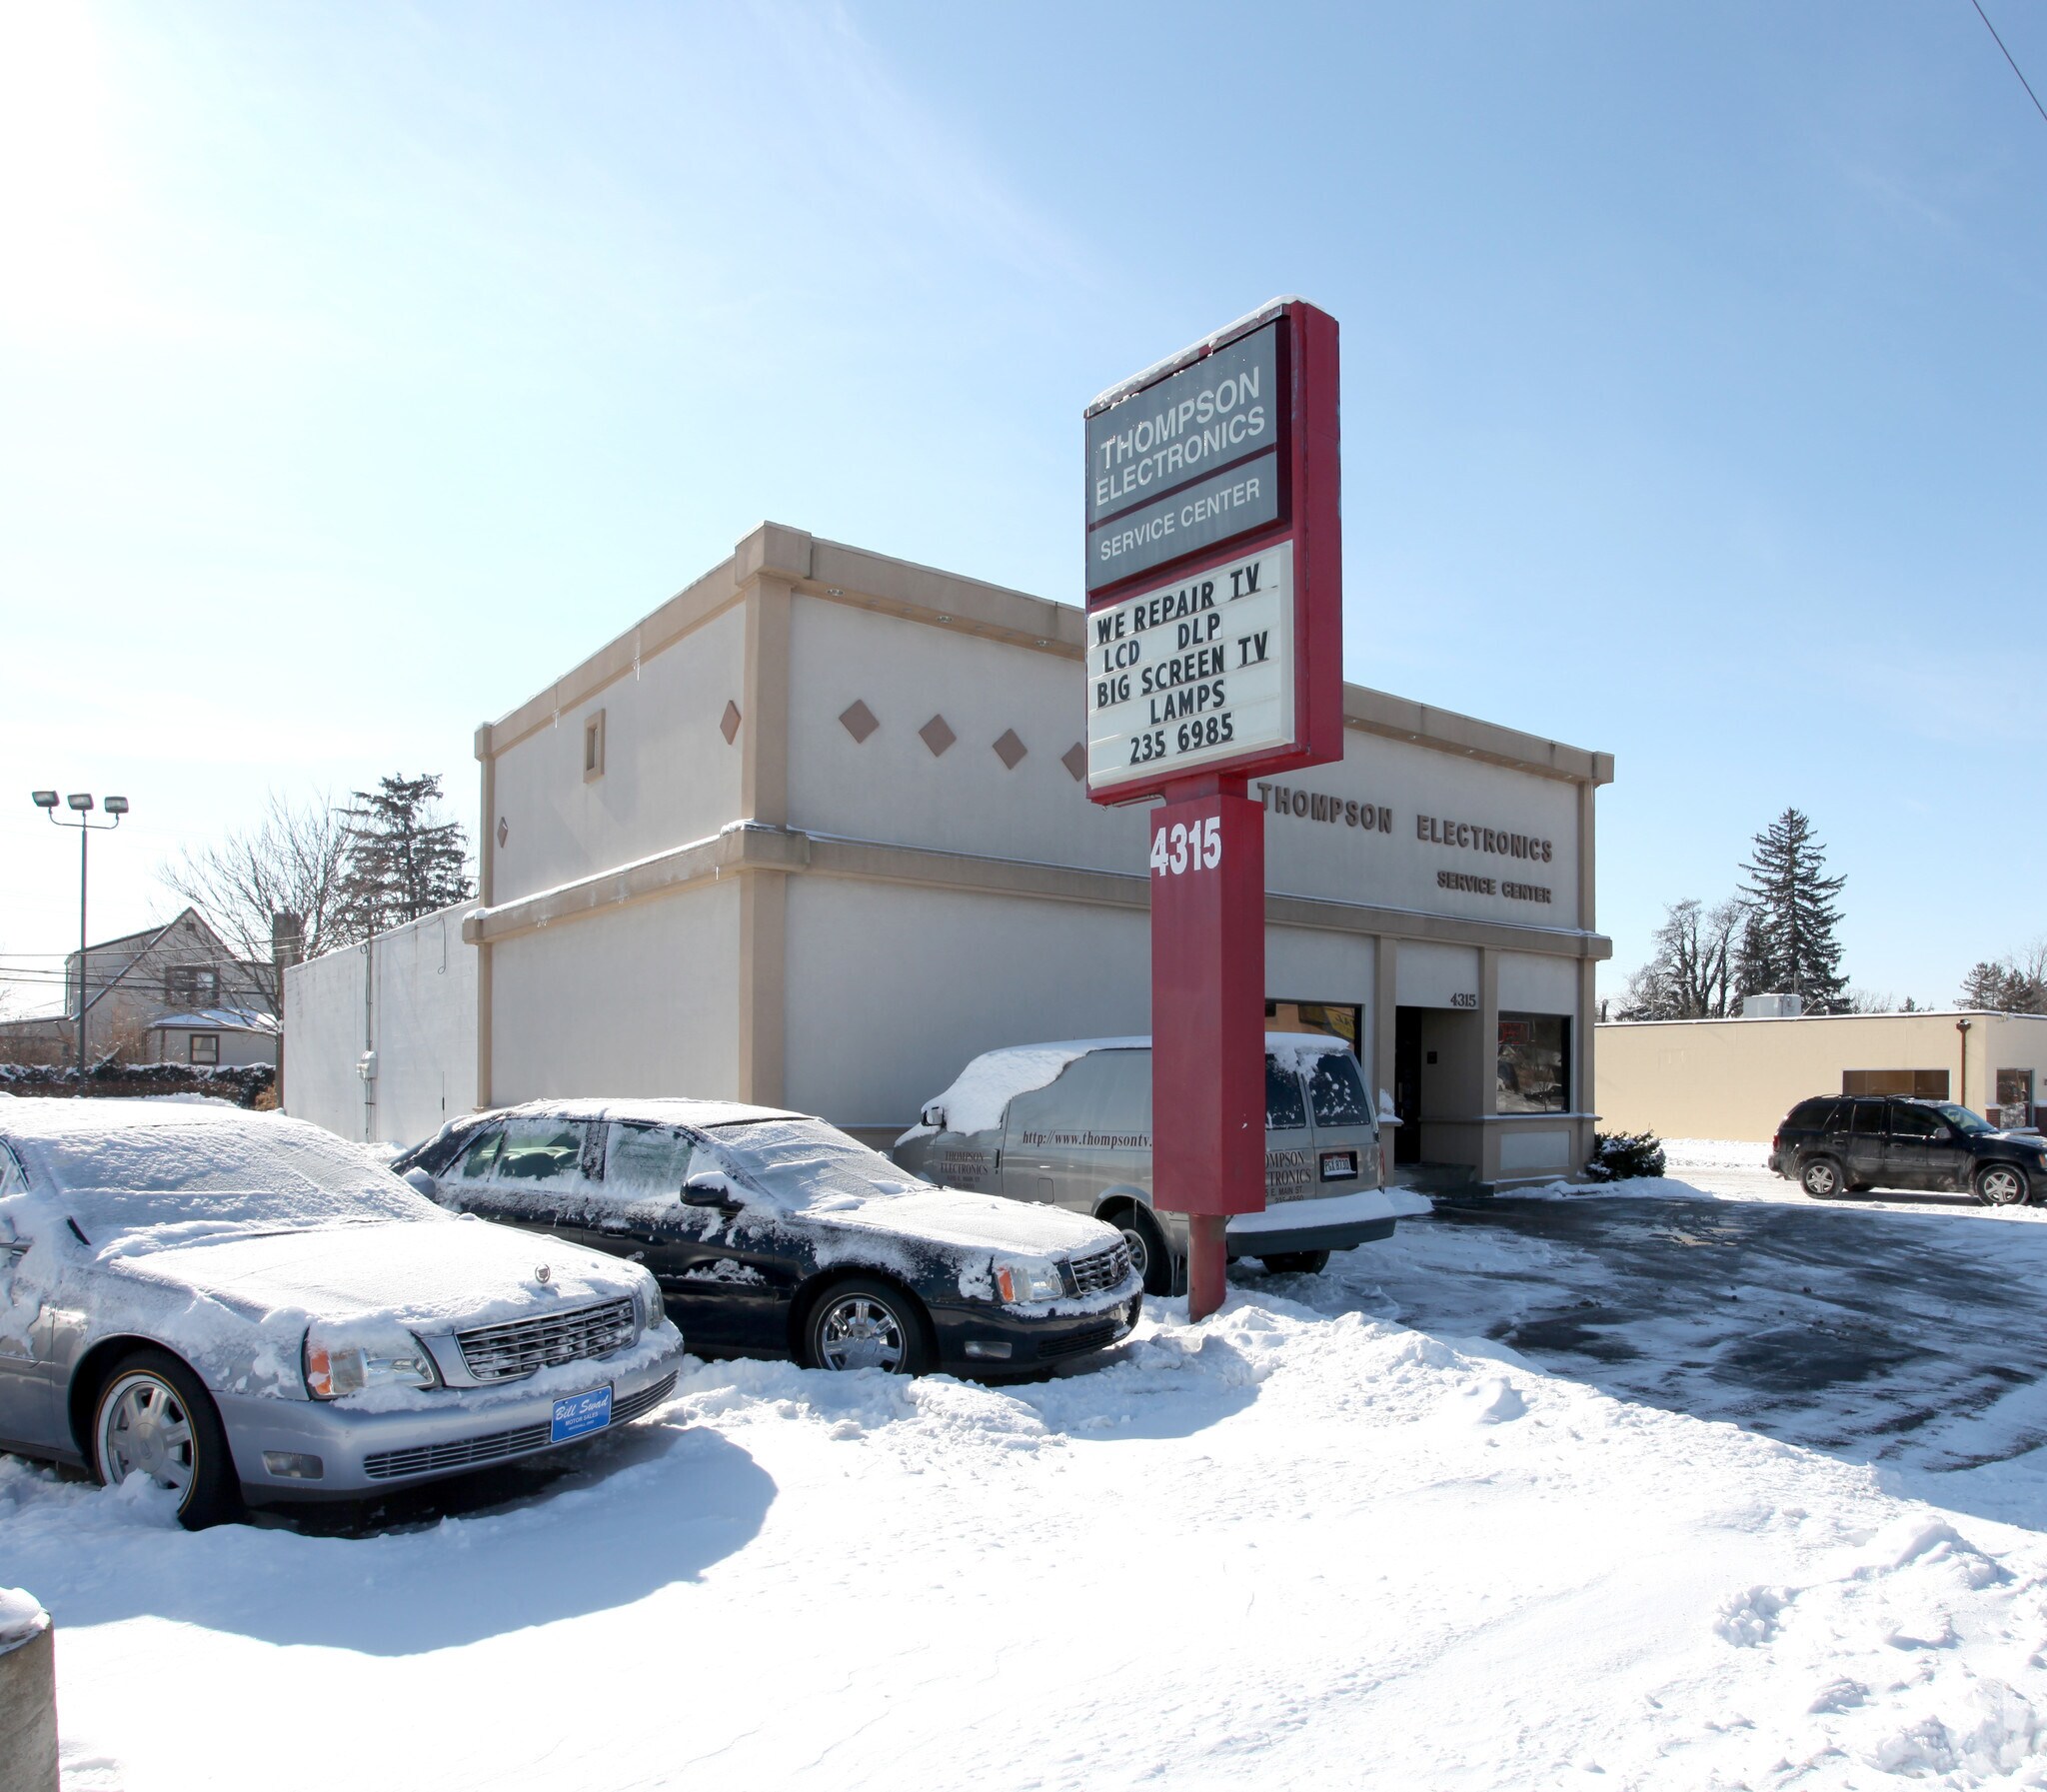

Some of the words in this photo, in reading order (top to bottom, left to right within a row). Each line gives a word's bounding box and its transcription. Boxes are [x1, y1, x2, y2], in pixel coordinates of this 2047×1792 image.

[1100, 366, 1259, 469] THOMPSON
[1096, 406, 1265, 507] ELECTRONICS
[1100, 513, 1175, 561] SERVICE
[1180, 478, 1259, 527] CENTER
[1097, 611, 1125, 645] WE
[1134, 581, 1214, 632] REPAIR
[1230, 563, 1259, 599] TV
[1103, 640, 1140, 673] LCD
[1177, 613, 1220, 650] DLP
[1097, 674, 1130, 708] BIG
[1141, 645, 1224, 695] SCREEN
[1238, 631, 1267, 665] TV
[1150, 680, 1225, 725] LAMPS
[1130, 731, 1166, 764] 235
[1177, 712, 1233, 751] 6985
[1150, 816, 1221, 877] 4315
[1257, 782, 1392, 834] THOMPSON
[1416, 814, 1553, 863] ELECTRONICS
[1437, 871, 1496, 896] SERVICE
[1501, 882, 1552, 903] CENTER
[1450, 992, 1476, 1007] 4315
[945, 1150, 984, 1162] THOMPSON
[1023, 1130, 1152, 1149] http://www.thompsontv.
[941, 1162, 989, 1176] ELECTRONICS
[1265, 1167, 1311, 1186] TRONICS
[556, 1403, 577, 1420] Bill
[580, 1395, 609, 1414] Swad
[565, 1415, 583, 1426] MOTOR
[584, 1411, 599, 1421] SALES
